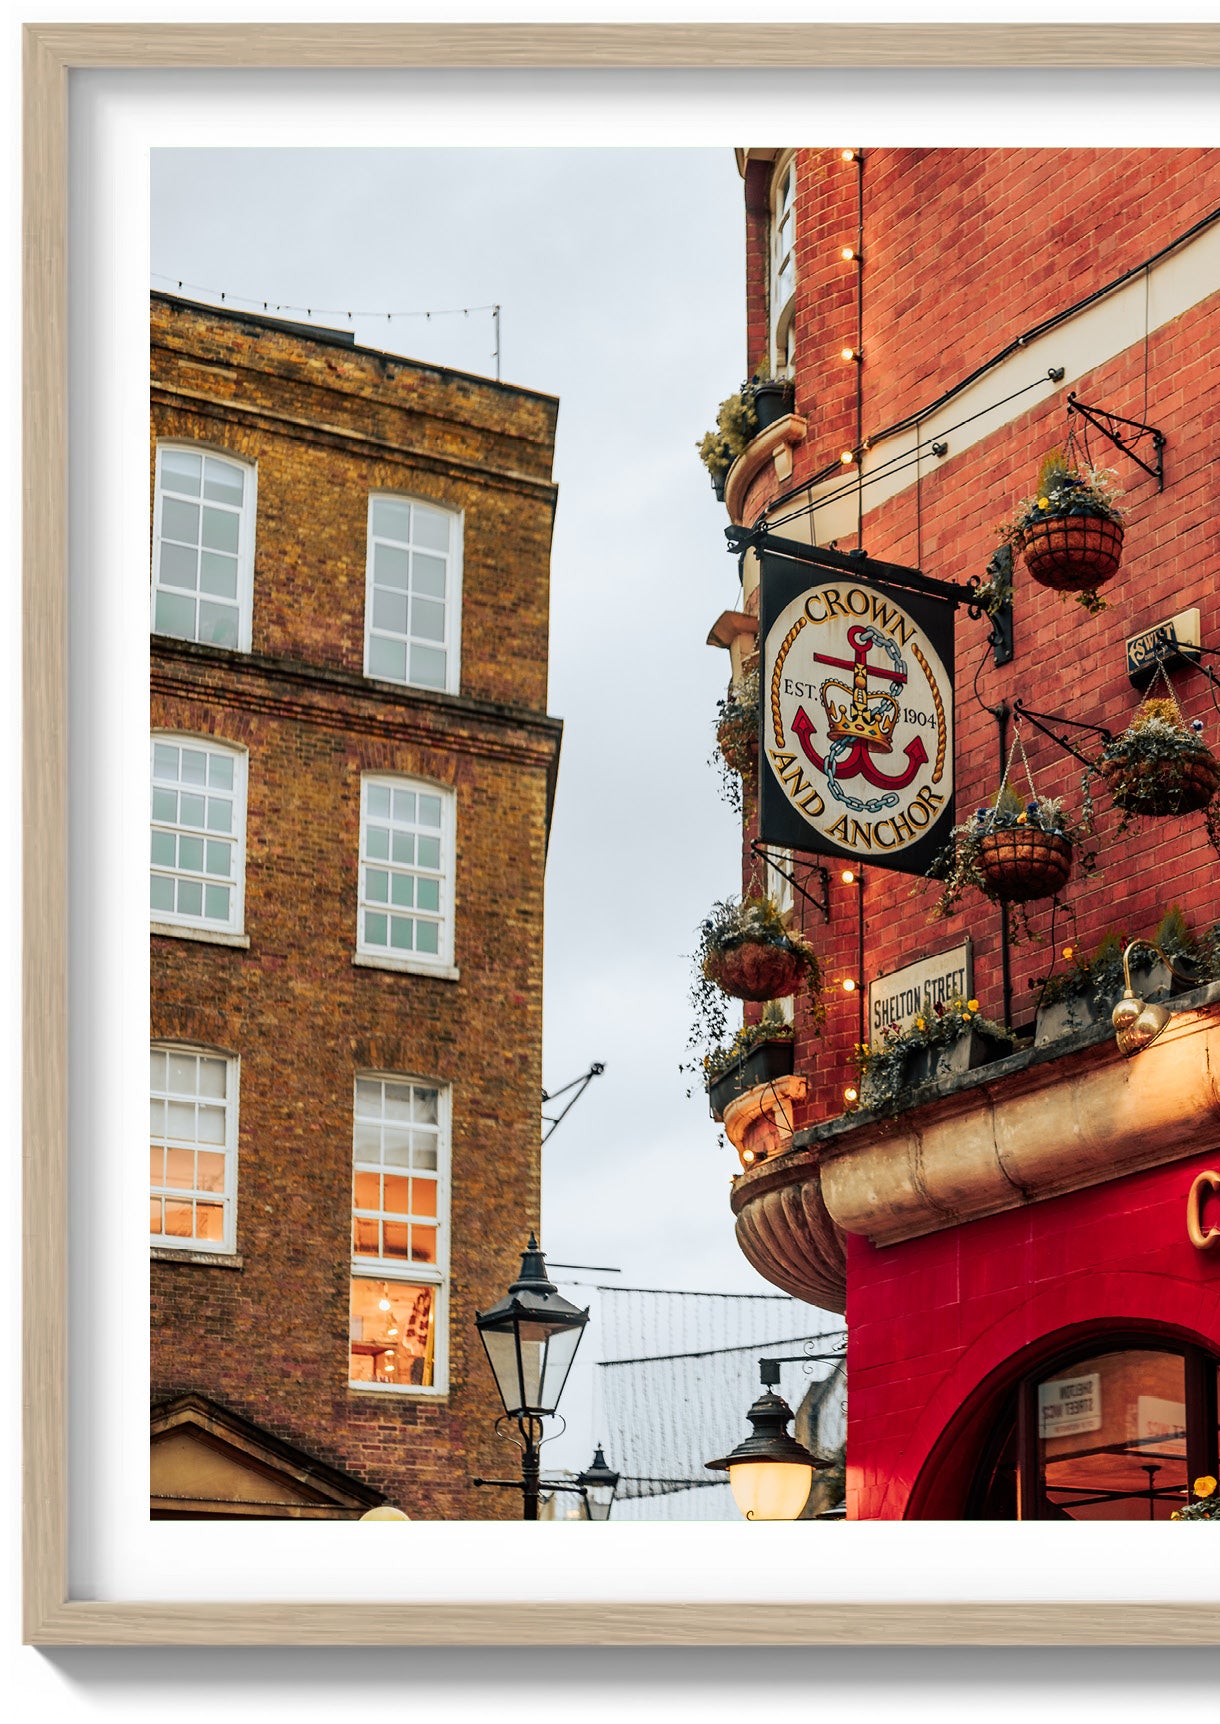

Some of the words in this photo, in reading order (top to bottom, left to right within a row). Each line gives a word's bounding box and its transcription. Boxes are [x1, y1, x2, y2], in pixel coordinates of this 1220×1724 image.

[803, 588, 917, 648] CROWN
[1136, 624, 1173, 660] SWIT
[783, 678, 818, 702] EST.
[903, 708, 938, 730] 1904
[768, 748, 826, 818] AND
[824, 784, 946, 851] ANCHOR
[874, 985, 921, 1029] SHELTON
[924, 968, 965, 1007] STREET
